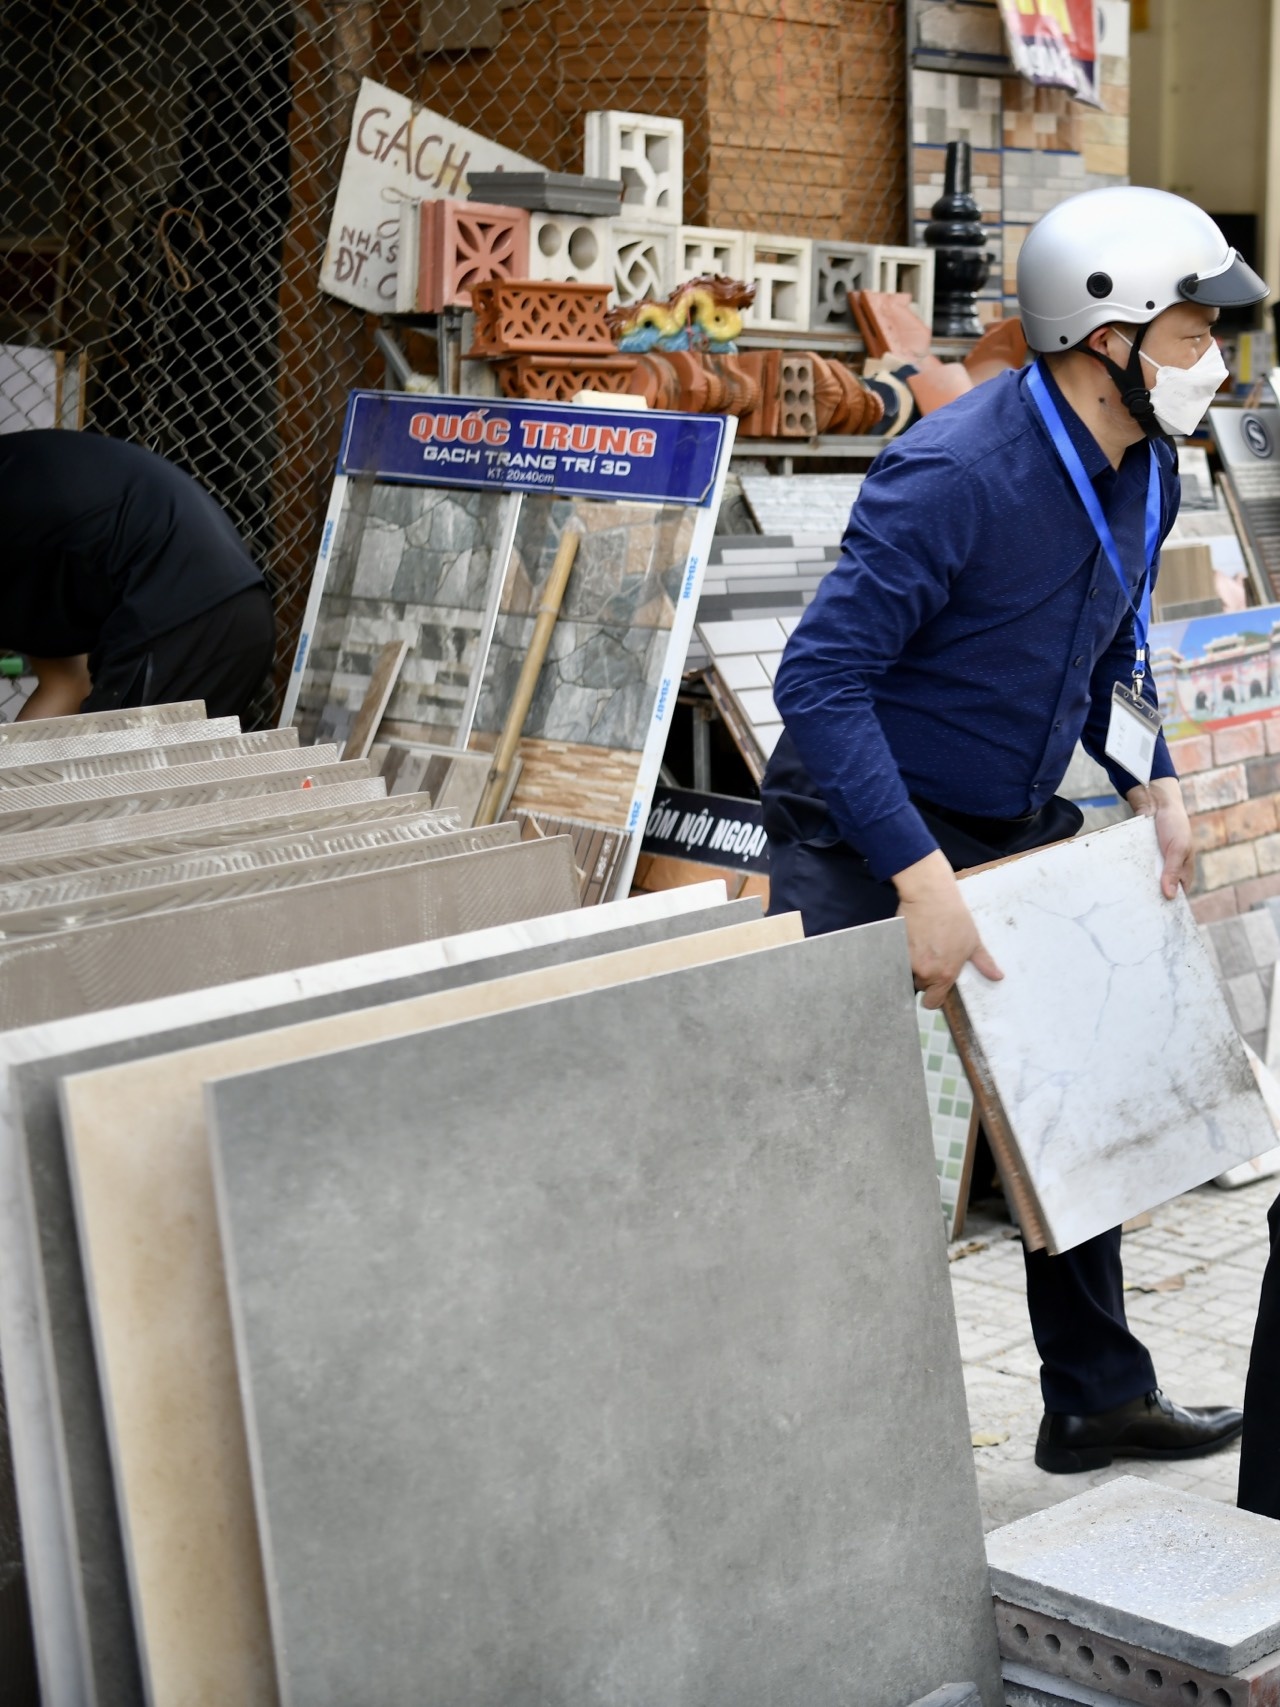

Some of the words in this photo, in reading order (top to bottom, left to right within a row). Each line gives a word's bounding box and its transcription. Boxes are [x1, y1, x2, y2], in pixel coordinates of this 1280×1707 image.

[409, 409, 511, 444] QUỐC
[520, 418, 658, 458] TRUNG
[424, 446, 486, 466] GẠCH
[487, 449, 557, 471] TRANG
[561, 455, 599, 473] TRÍ
[600, 461, 632, 477] 3D
[487, 467, 504, 480] KT:
[505, 469, 555, 485] 20x40cm
[654, 676, 672, 722] 20407
[645, 798, 680, 840] ỐM
[674, 808, 714, 852] NỘI
[708, 818, 768, 862] NGOẠI
